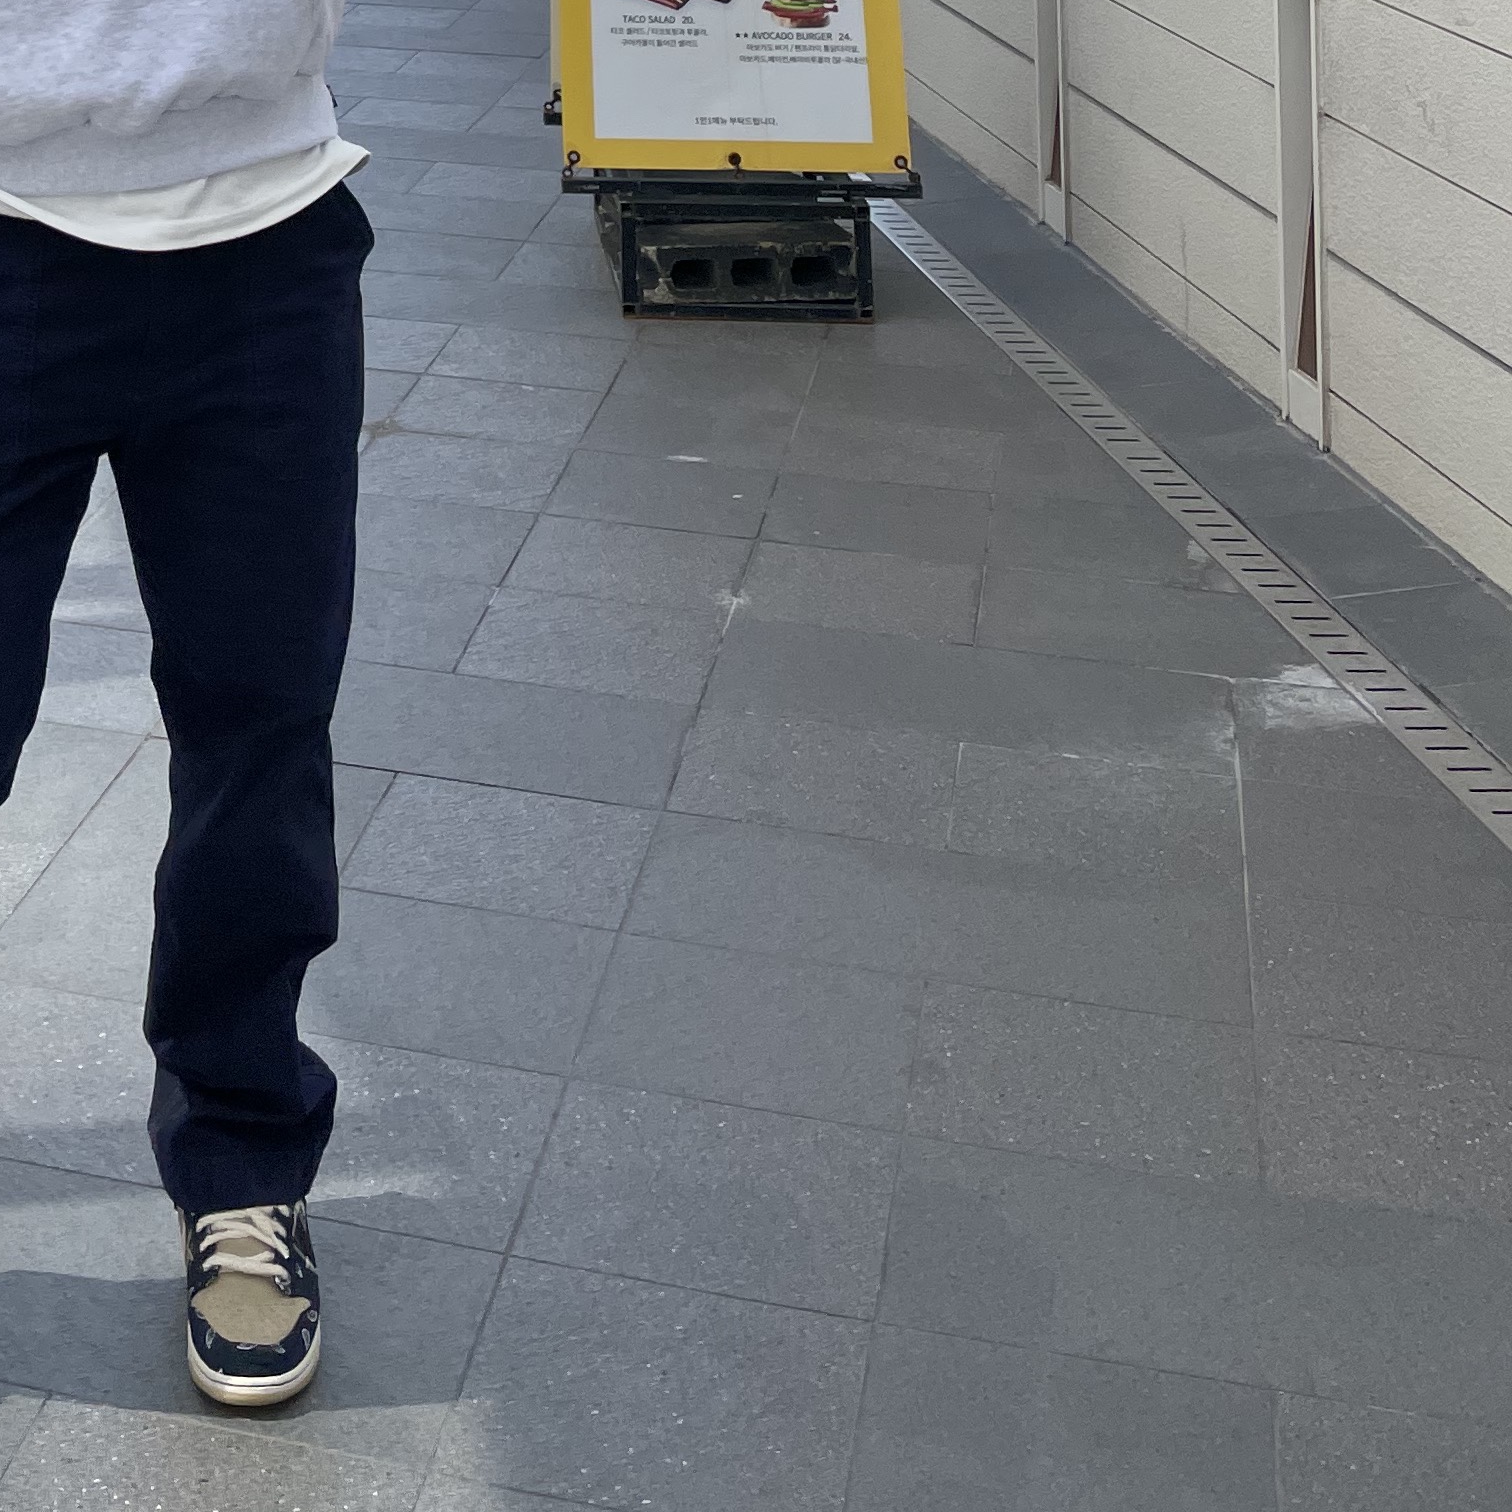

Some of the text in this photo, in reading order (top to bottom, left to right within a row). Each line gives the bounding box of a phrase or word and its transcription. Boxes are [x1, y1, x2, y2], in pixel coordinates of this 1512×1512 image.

[622, 15, 646, 23] TACO
[648, 15, 676, 23] SALAD
[751, 32, 794, 40] AVOCADO
[796, 33, 833, 41] BURGER
